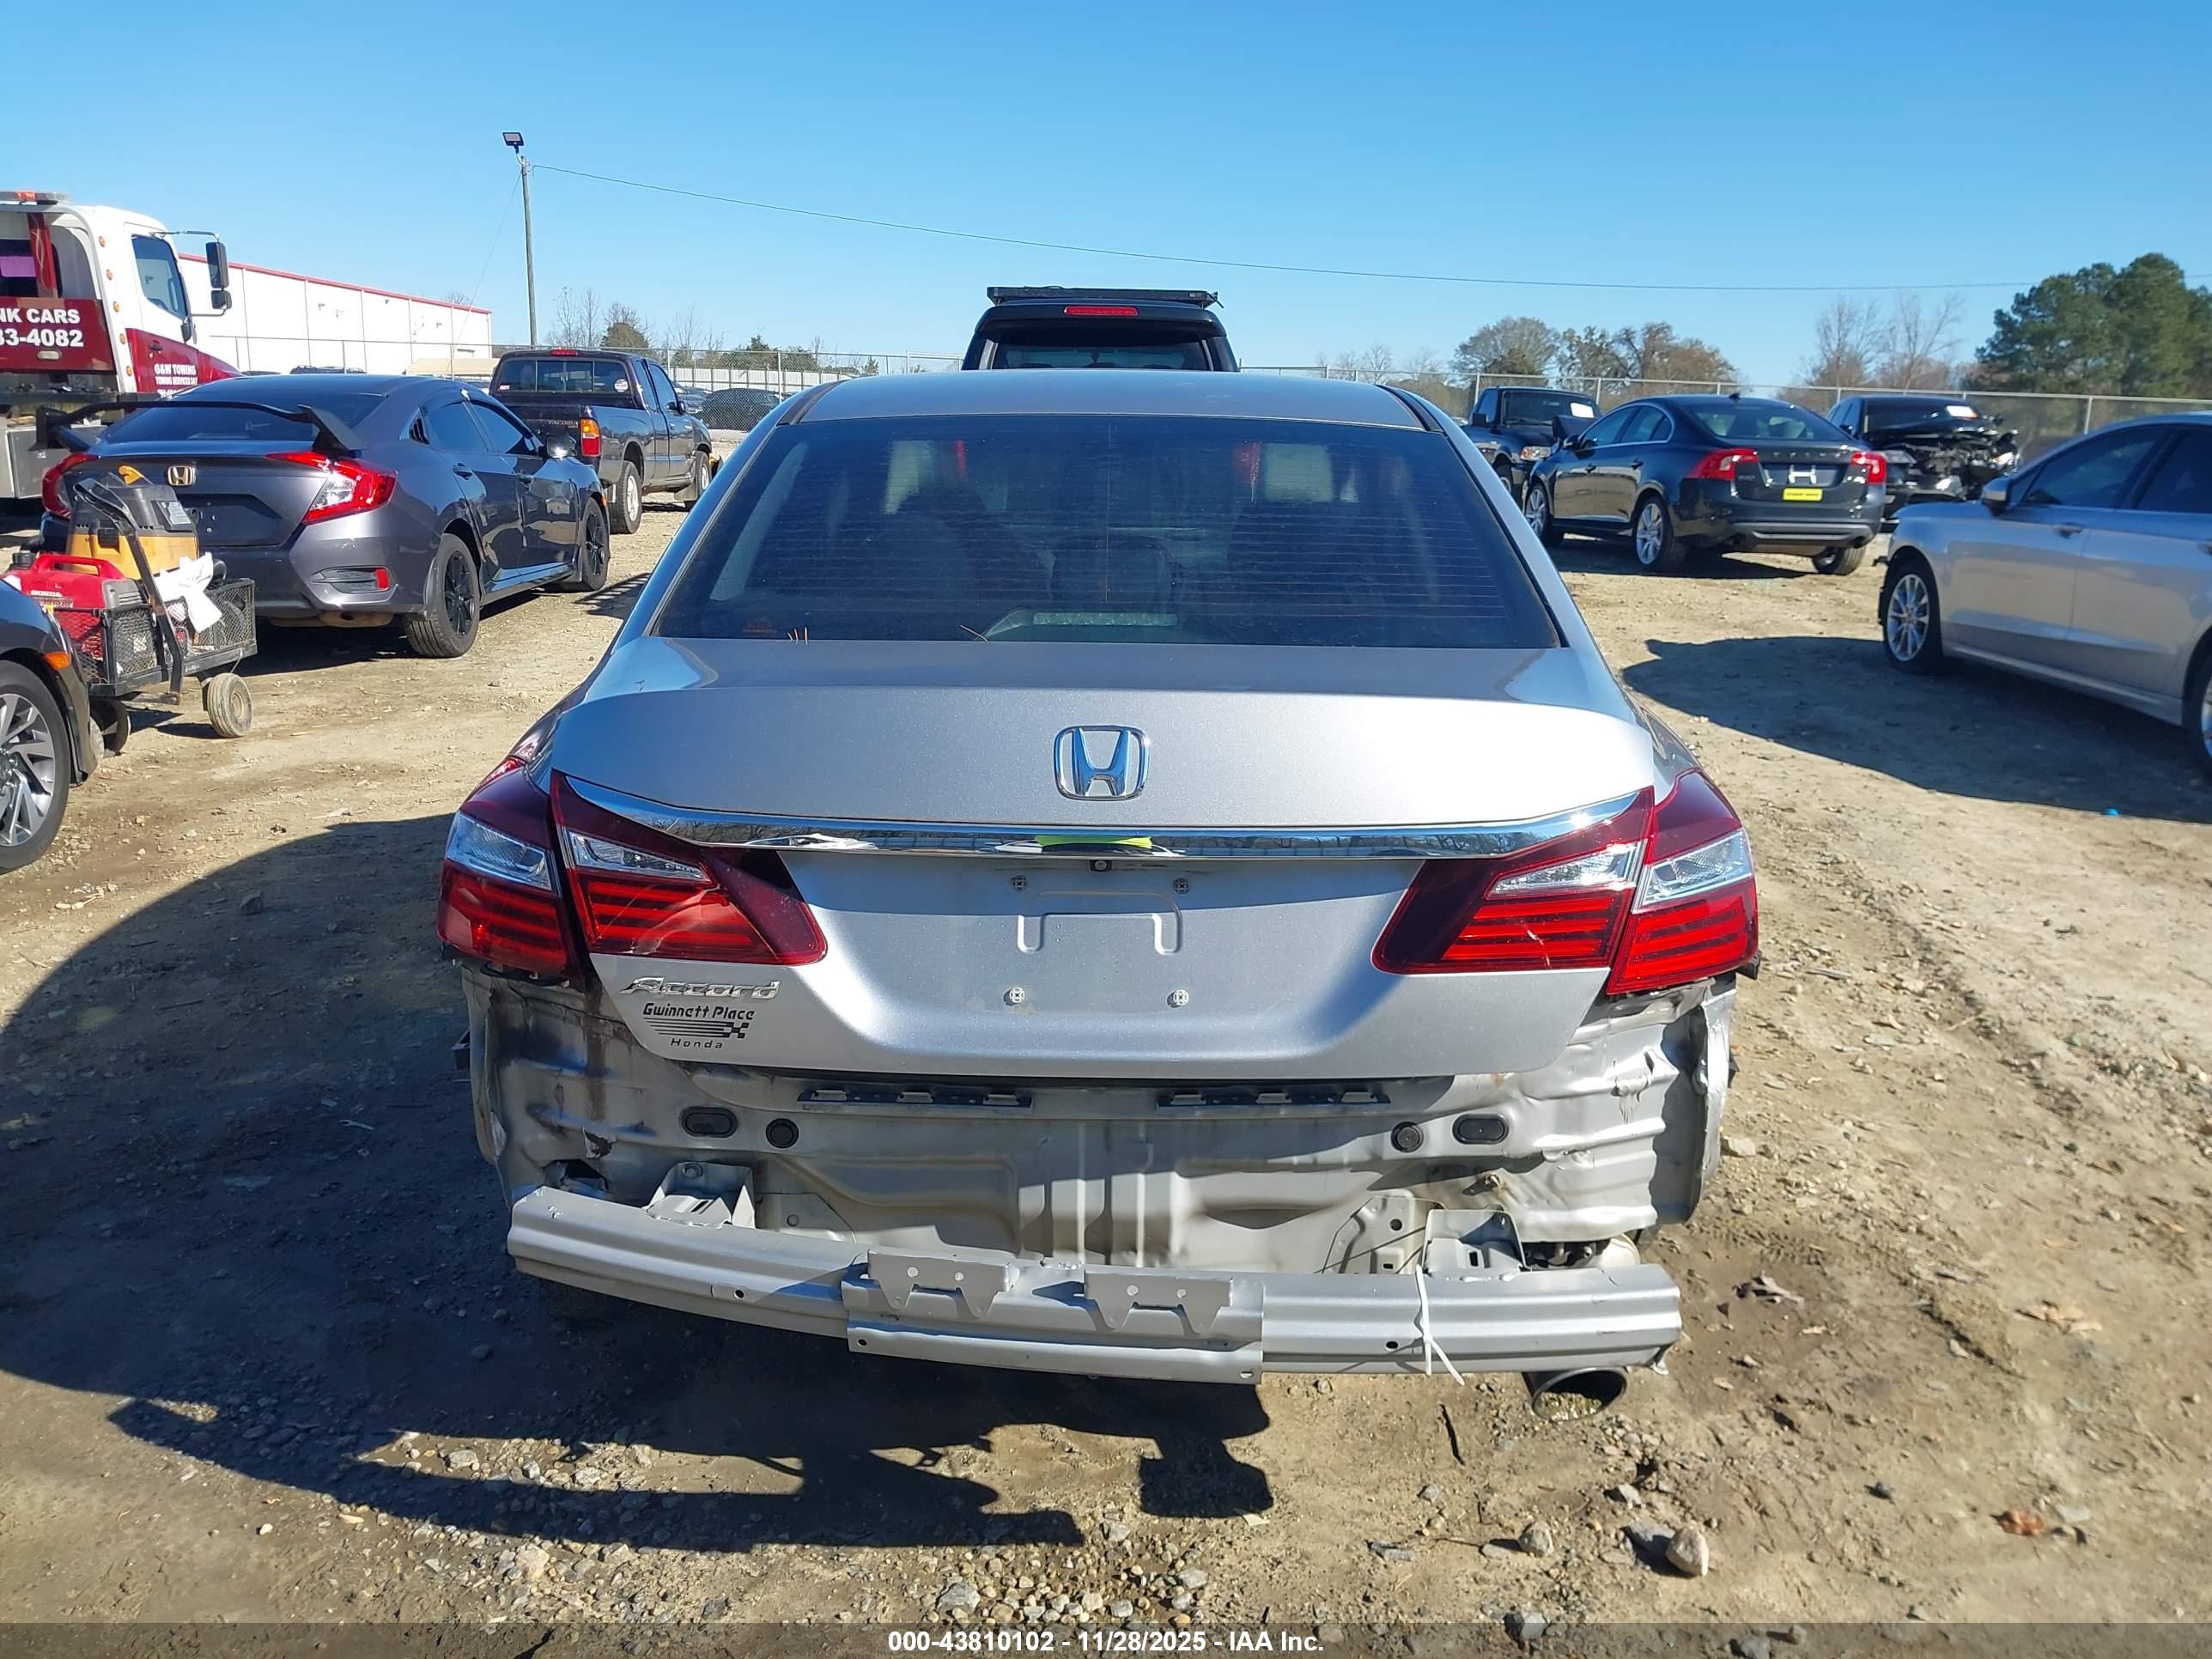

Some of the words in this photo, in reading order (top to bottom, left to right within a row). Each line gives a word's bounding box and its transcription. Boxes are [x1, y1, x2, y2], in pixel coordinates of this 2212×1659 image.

[27, 309, 81, 324] CARS
[172, 364, 197, 375] TOWING
[619, 977, 781, 1000] Accord
[643, 1002, 709, 1018] Gwinnett
[712, 1006, 755, 1020] Place
[670, 1037, 723, 1049] Honda
